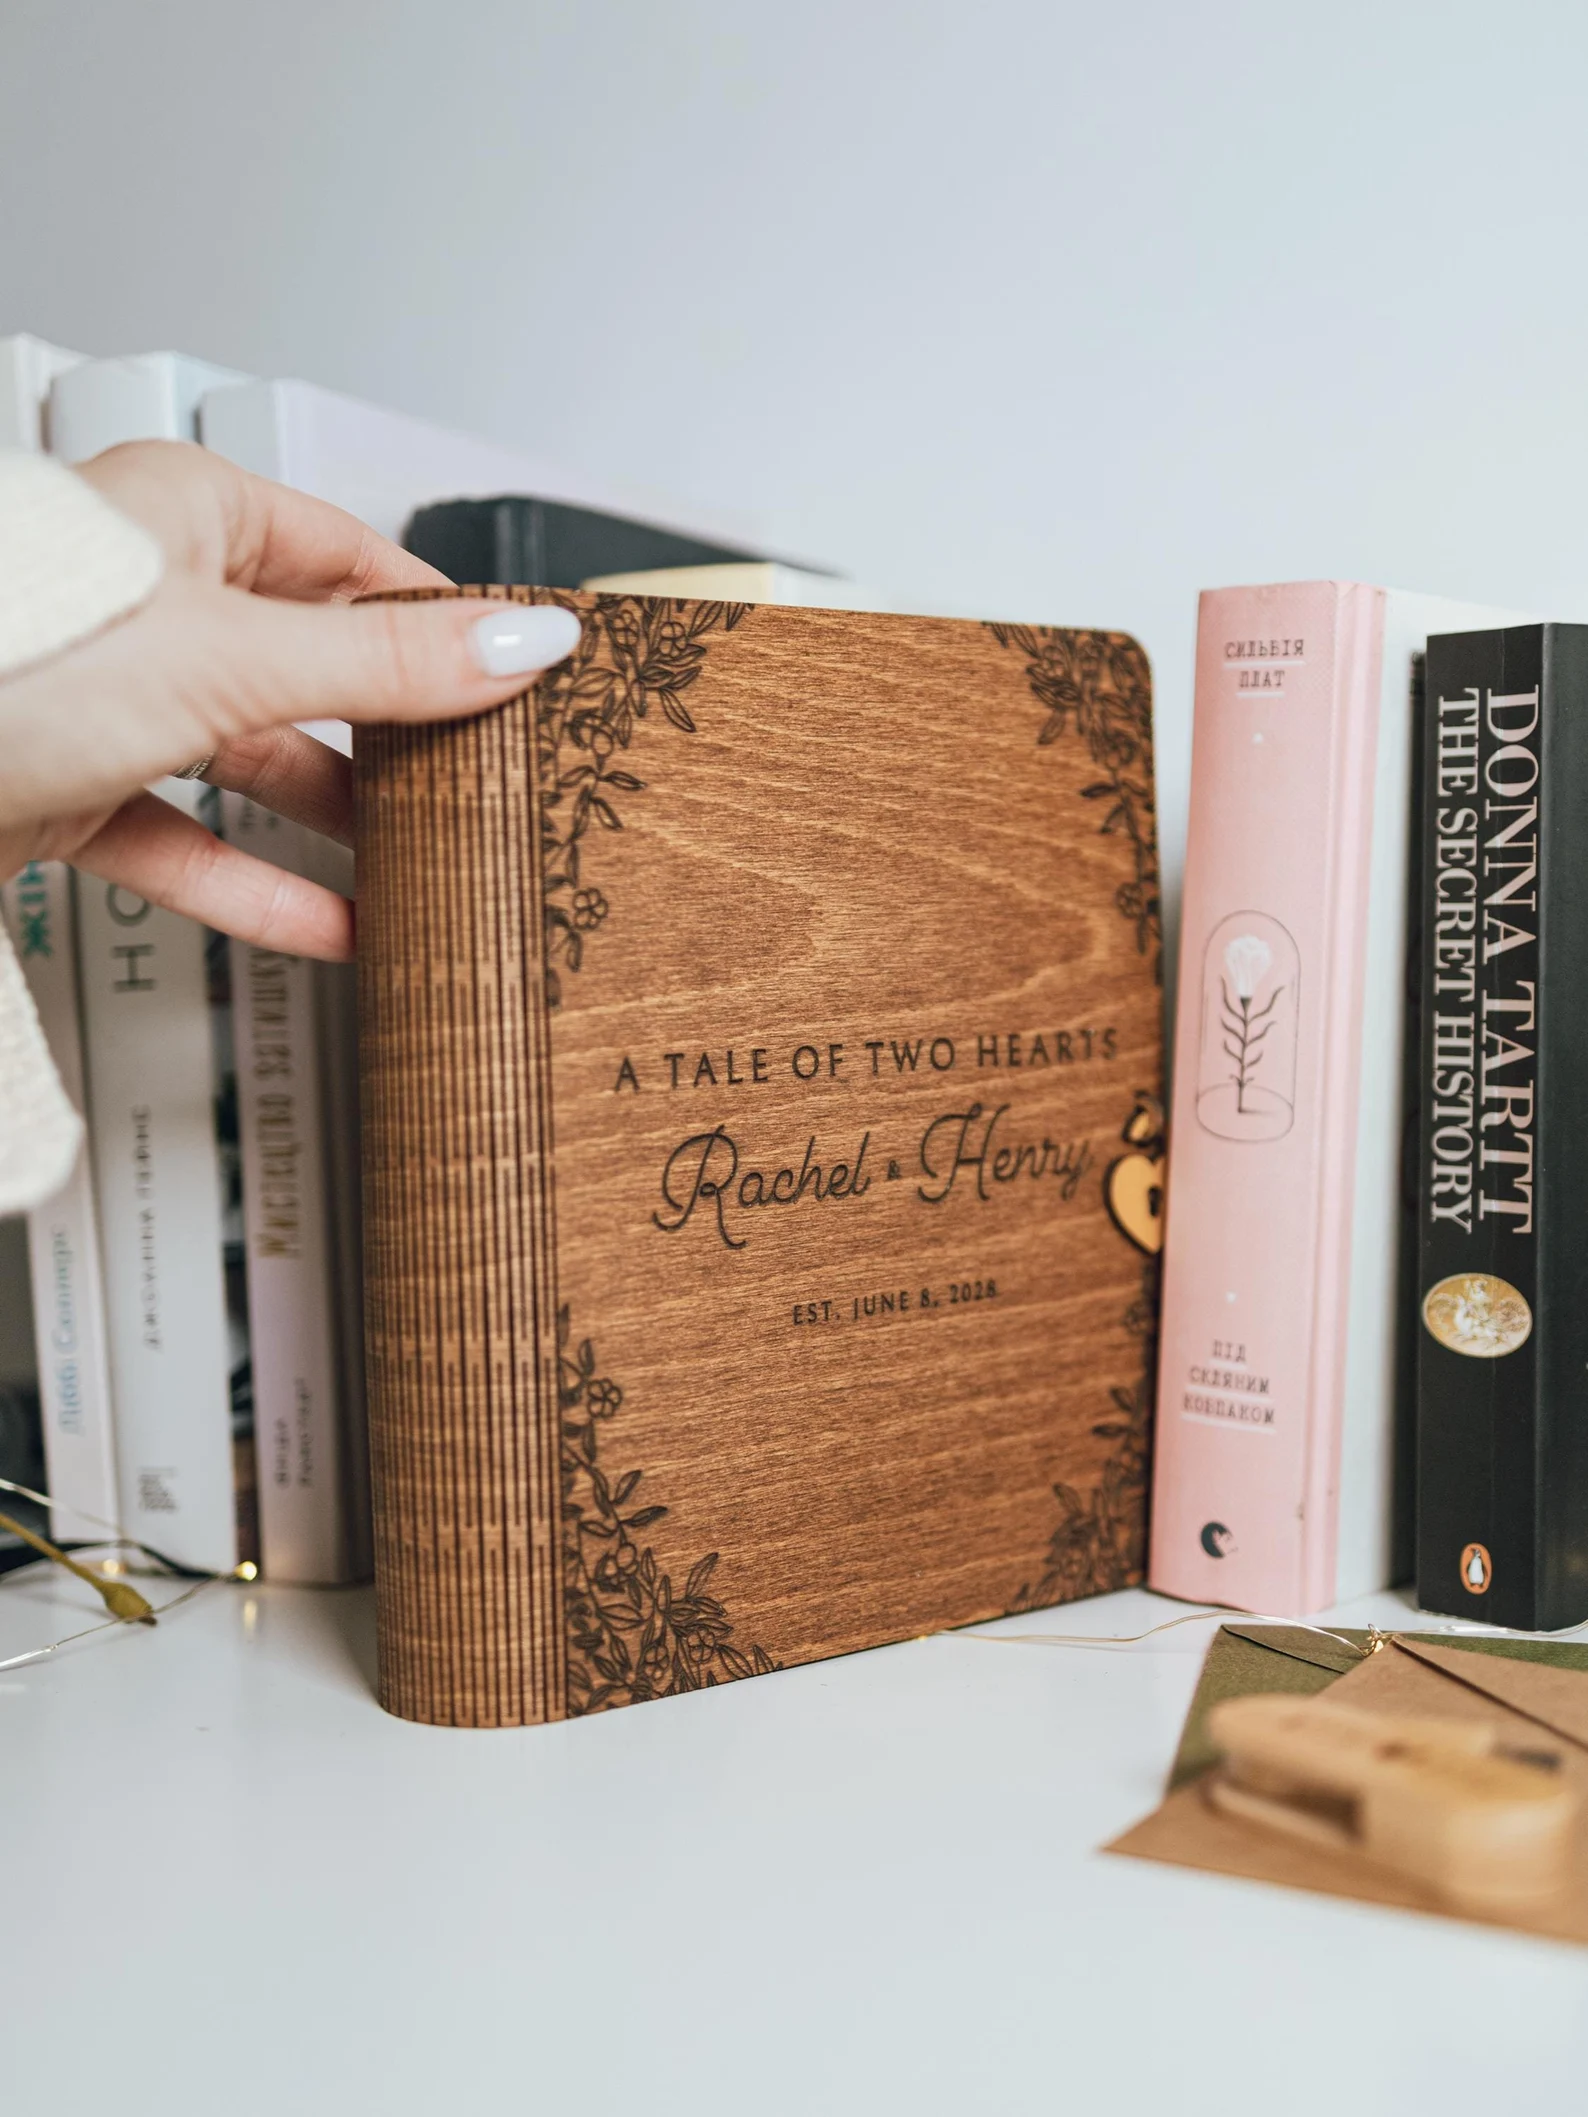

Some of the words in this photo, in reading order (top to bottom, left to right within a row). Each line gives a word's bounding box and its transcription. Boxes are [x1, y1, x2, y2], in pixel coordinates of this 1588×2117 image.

[1224, 639, 1304, 658] СИЛЬВІЯ
[1239, 670, 1285, 687] ПЛАТ
[1437, 687, 1480, 797] THE
[1481, 684, 1540, 965] DONNA
[1433, 807, 1478, 1003] SECRET
[613, 1057, 640, 1092] A
[664, 1047, 769, 1089] TALE
[792, 1043, 845, 1080] OF
[866, 1036, 956, 1075] TWO
[977, 1028, 1118, 1068] HEARTS
[1430, 1011, 1476, 1234] HISTORY
[1477, 979, 1536, 1234] TARTT
[652, 1124, 871, 1250] Rachel
[886, 1160, 900, 1181] &
[917, 1102, 1095, 1201] Henry
[793, 1301, 841, 1326] EST.
[852, 1291, 909, 1321] JUNE
